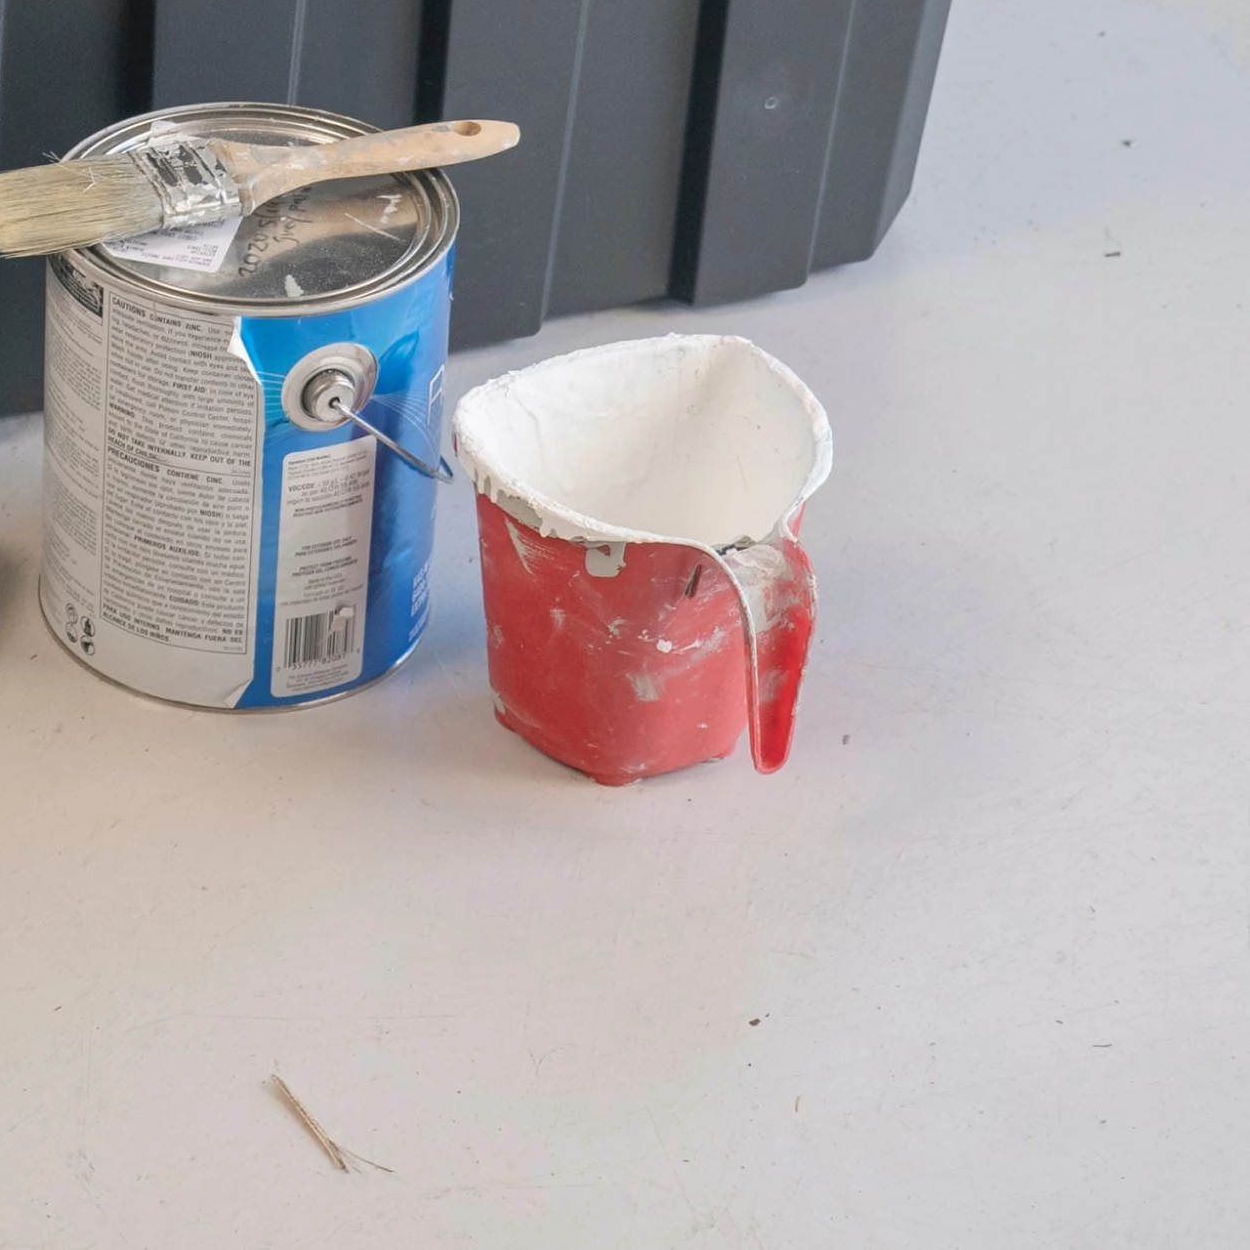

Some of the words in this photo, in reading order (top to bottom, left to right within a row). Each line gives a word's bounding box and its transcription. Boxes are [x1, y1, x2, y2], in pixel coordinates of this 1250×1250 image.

[238, 234, 269, 277] 2020
[112, 296, 145, 316] CAUTIONS
[175, 330, 186, 339] you
[172, 381, 191, 391] FIRST
[117, 431, 128, 440] NOT
[190, 452, 207, 461] KEEP
[210, 456, 223, 464] OUT
